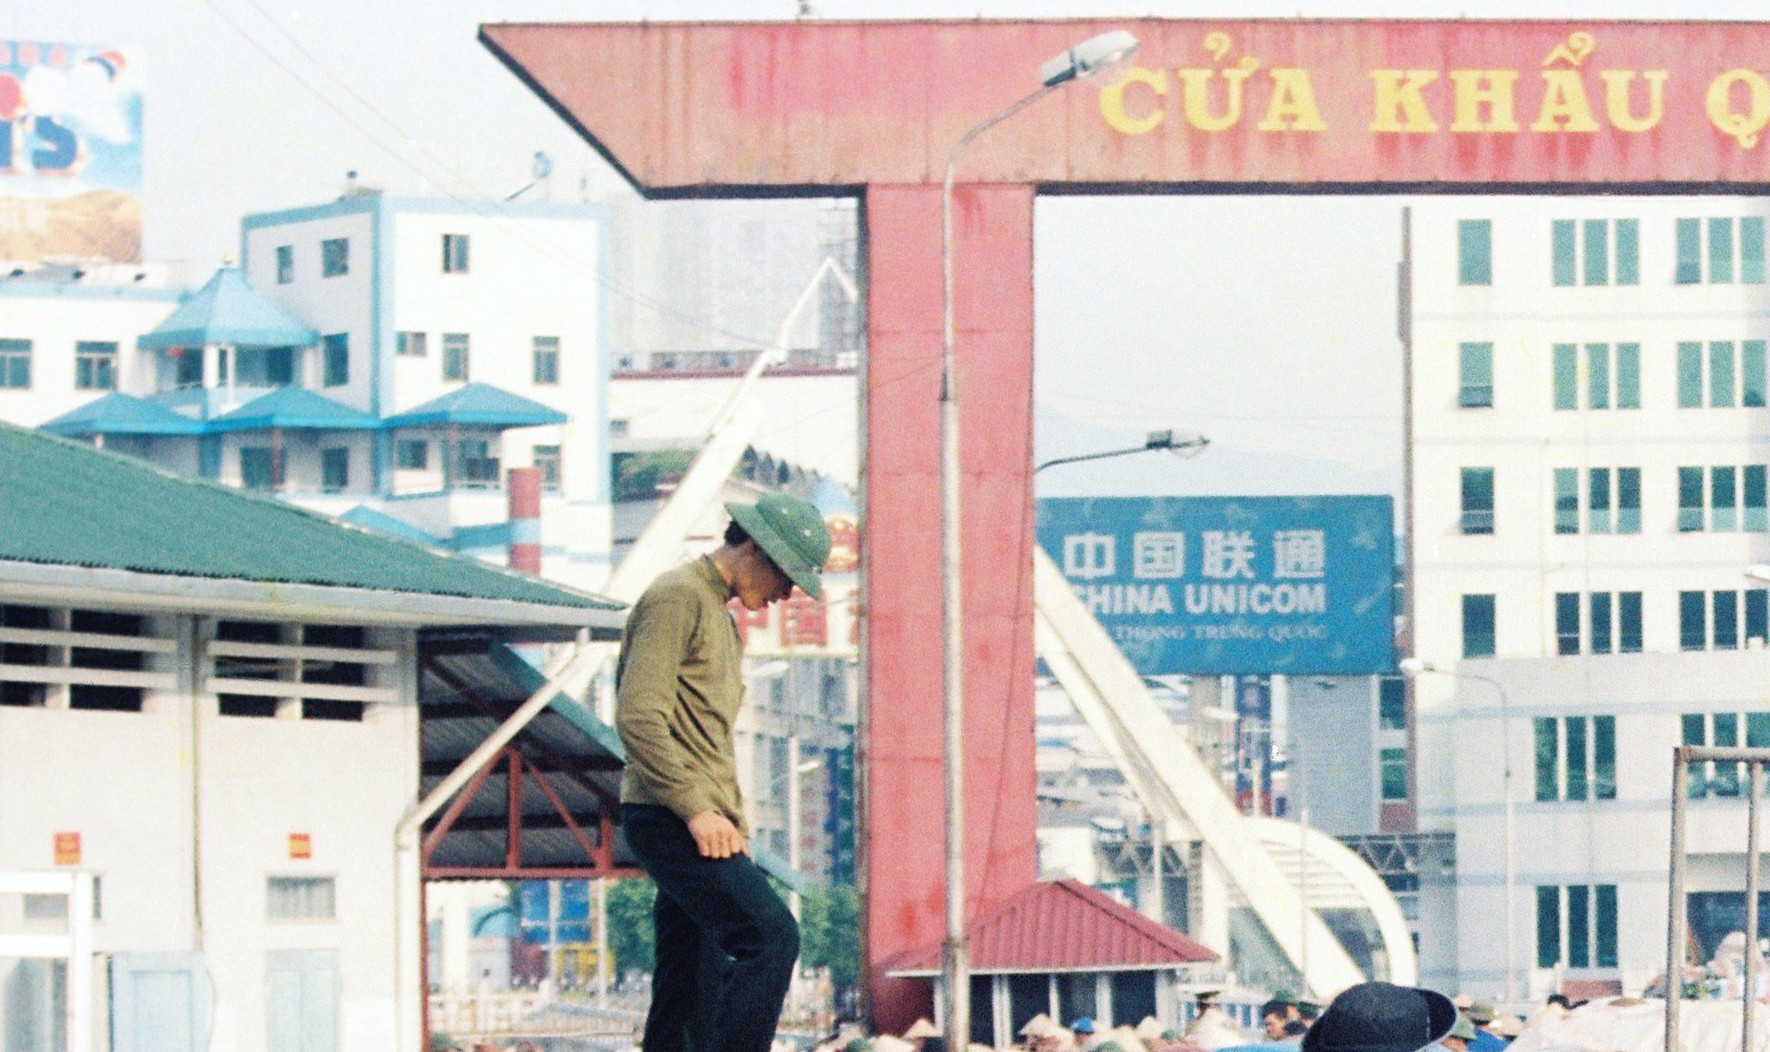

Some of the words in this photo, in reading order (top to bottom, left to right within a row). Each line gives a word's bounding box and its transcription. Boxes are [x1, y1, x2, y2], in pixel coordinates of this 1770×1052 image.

[1100, 32, 1328, 135] CỬA
[1369, 32, 1669, 134] KHẨU
[1064, 530, 1325, 580] 中国联通
[1184, 583, 1327, 614] UNICOM
